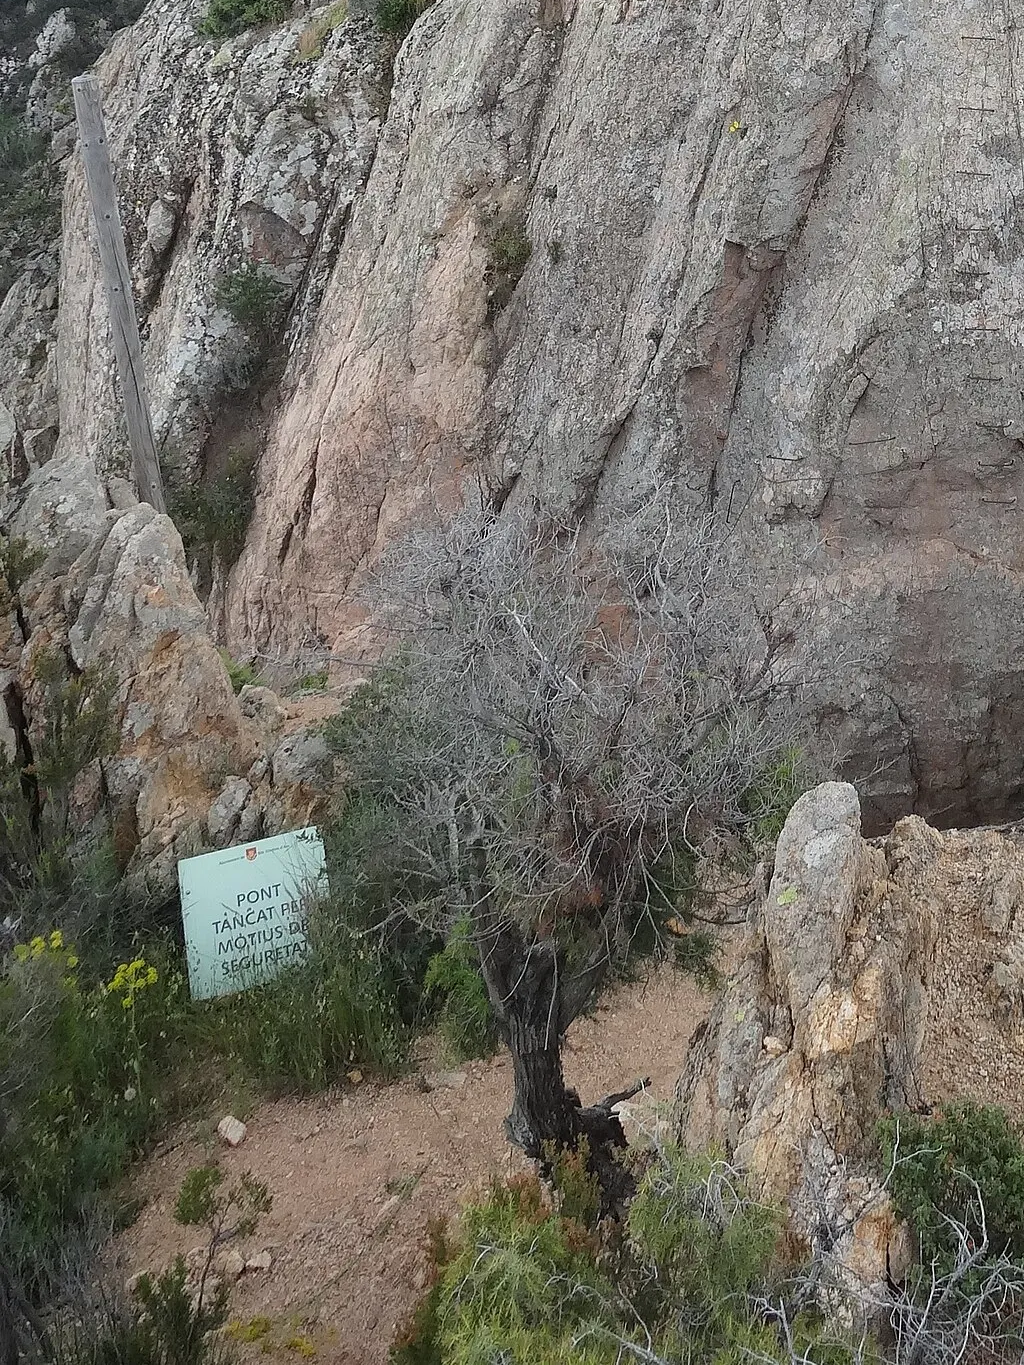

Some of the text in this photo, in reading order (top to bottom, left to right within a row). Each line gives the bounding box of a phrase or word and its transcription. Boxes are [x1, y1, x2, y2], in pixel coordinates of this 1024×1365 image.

[237, 884, 281, 907] PONT
[212, 906, 275, 935] TANCAT
[218, 925, 283, 955] MOTIUS
[222, 939, 308, 976] SEGURETAT
